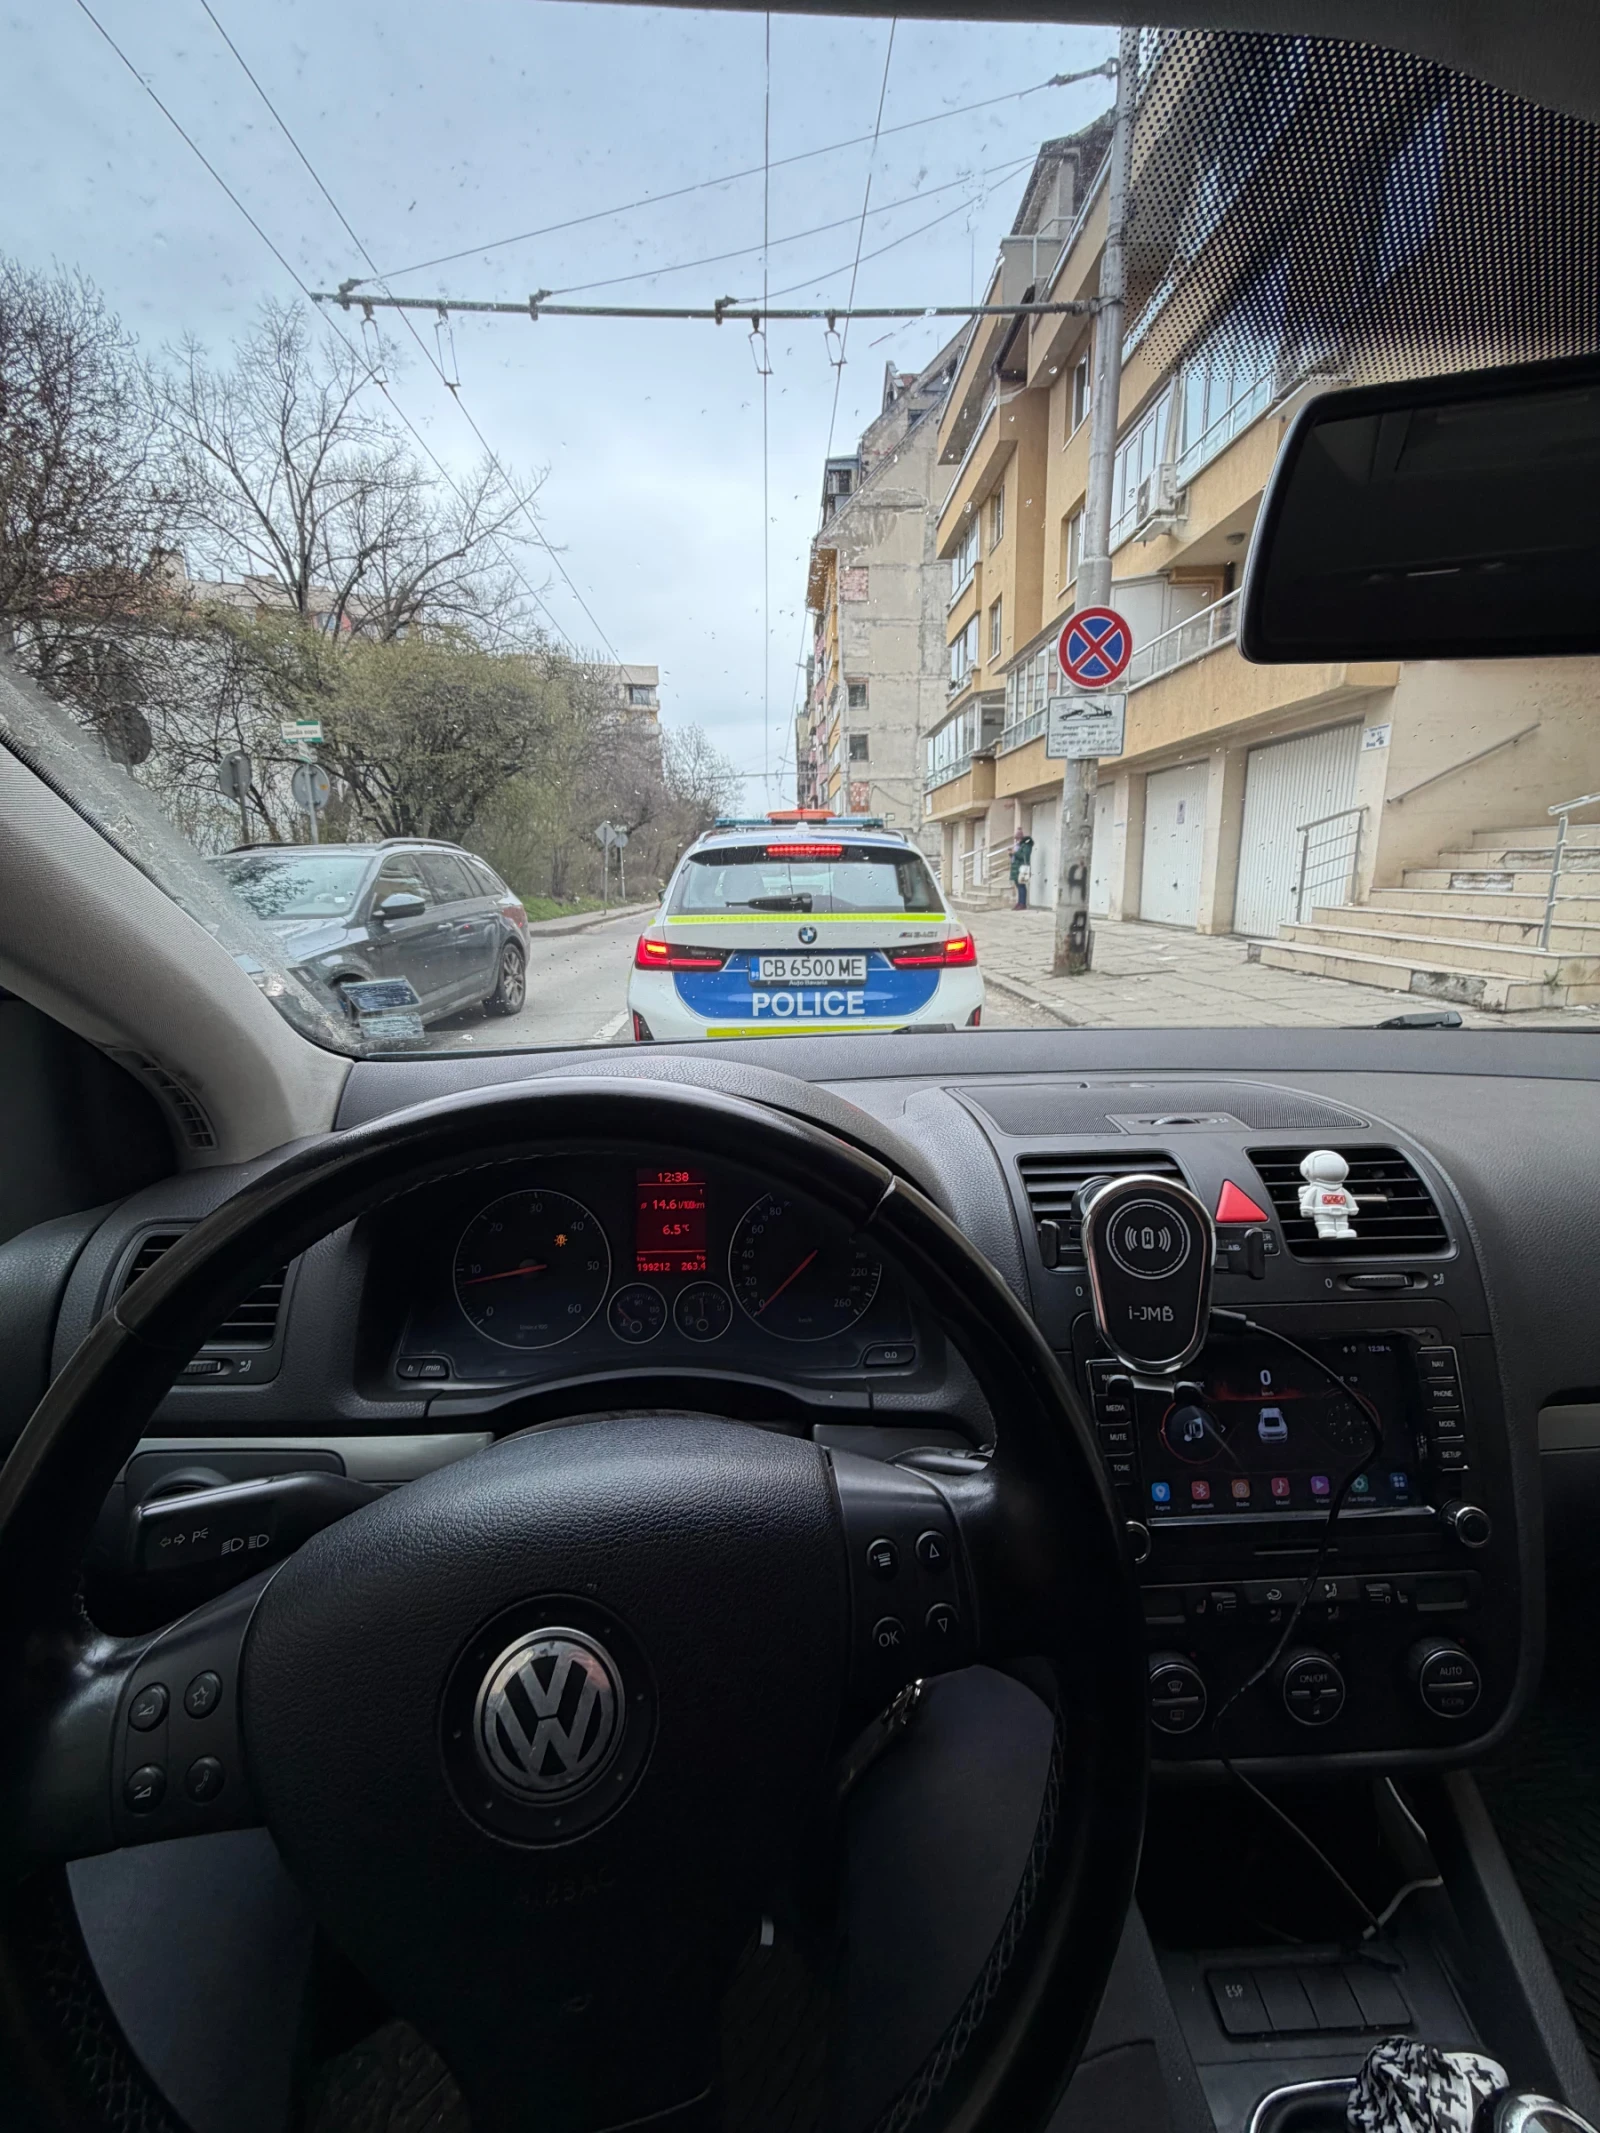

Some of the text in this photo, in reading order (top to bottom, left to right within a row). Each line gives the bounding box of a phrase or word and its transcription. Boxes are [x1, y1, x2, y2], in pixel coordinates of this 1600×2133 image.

[763, 959, 862, 977] CB 6500 ME
[752, 991, 865, 1017] POLICE
[657, 1172, 689, 1182] 12:38
[530, 1202, 543, 1213] 30
[652, 1199, 677, 1209] 14.6
[769, 1207, 782, 1215] 80
[489, 1223, 503, 1233] 20
[570, 1221, 584, 1231] 40
[752, 1225, 764, 1233] 60
[742, 1250, 754, 1258] 40
[470, 1264, 481, 1274] 10
[586, 1261, 600, 1271] 50
[637, 1262, 671, 1271] 199212
[681, 1262, 706, 1271] 263.4
[851, 1268, 867, 1276] 220
[745, 1277, 757, 1285] 20
[1325, 1278, 1332, 1288] 0
[834, 1299, 851, 1307] 260
[567, 1304, 582, 1313] 60
[1128, 1306, 1175, 1322] i-JMB
[1260, 1369, 1272, 1385] 0
[1433, 1390, 1453, 1398] PHONE
[1105, 1404, 1126, 1412] MEDIA
[1438, 1420, 1456, 1428] MODE
[1109, 1433, 1128, 1441] MUTE
[1441, 1450, 1461, 1459] SETUP
[879, 1630, 900, 1648] OK
[1439, 1666, 1463, 1677] AUTO
[1300, 1673, 1328, 1684] ON/OFF
[1225, 1984, 1243, 1998] ESP
